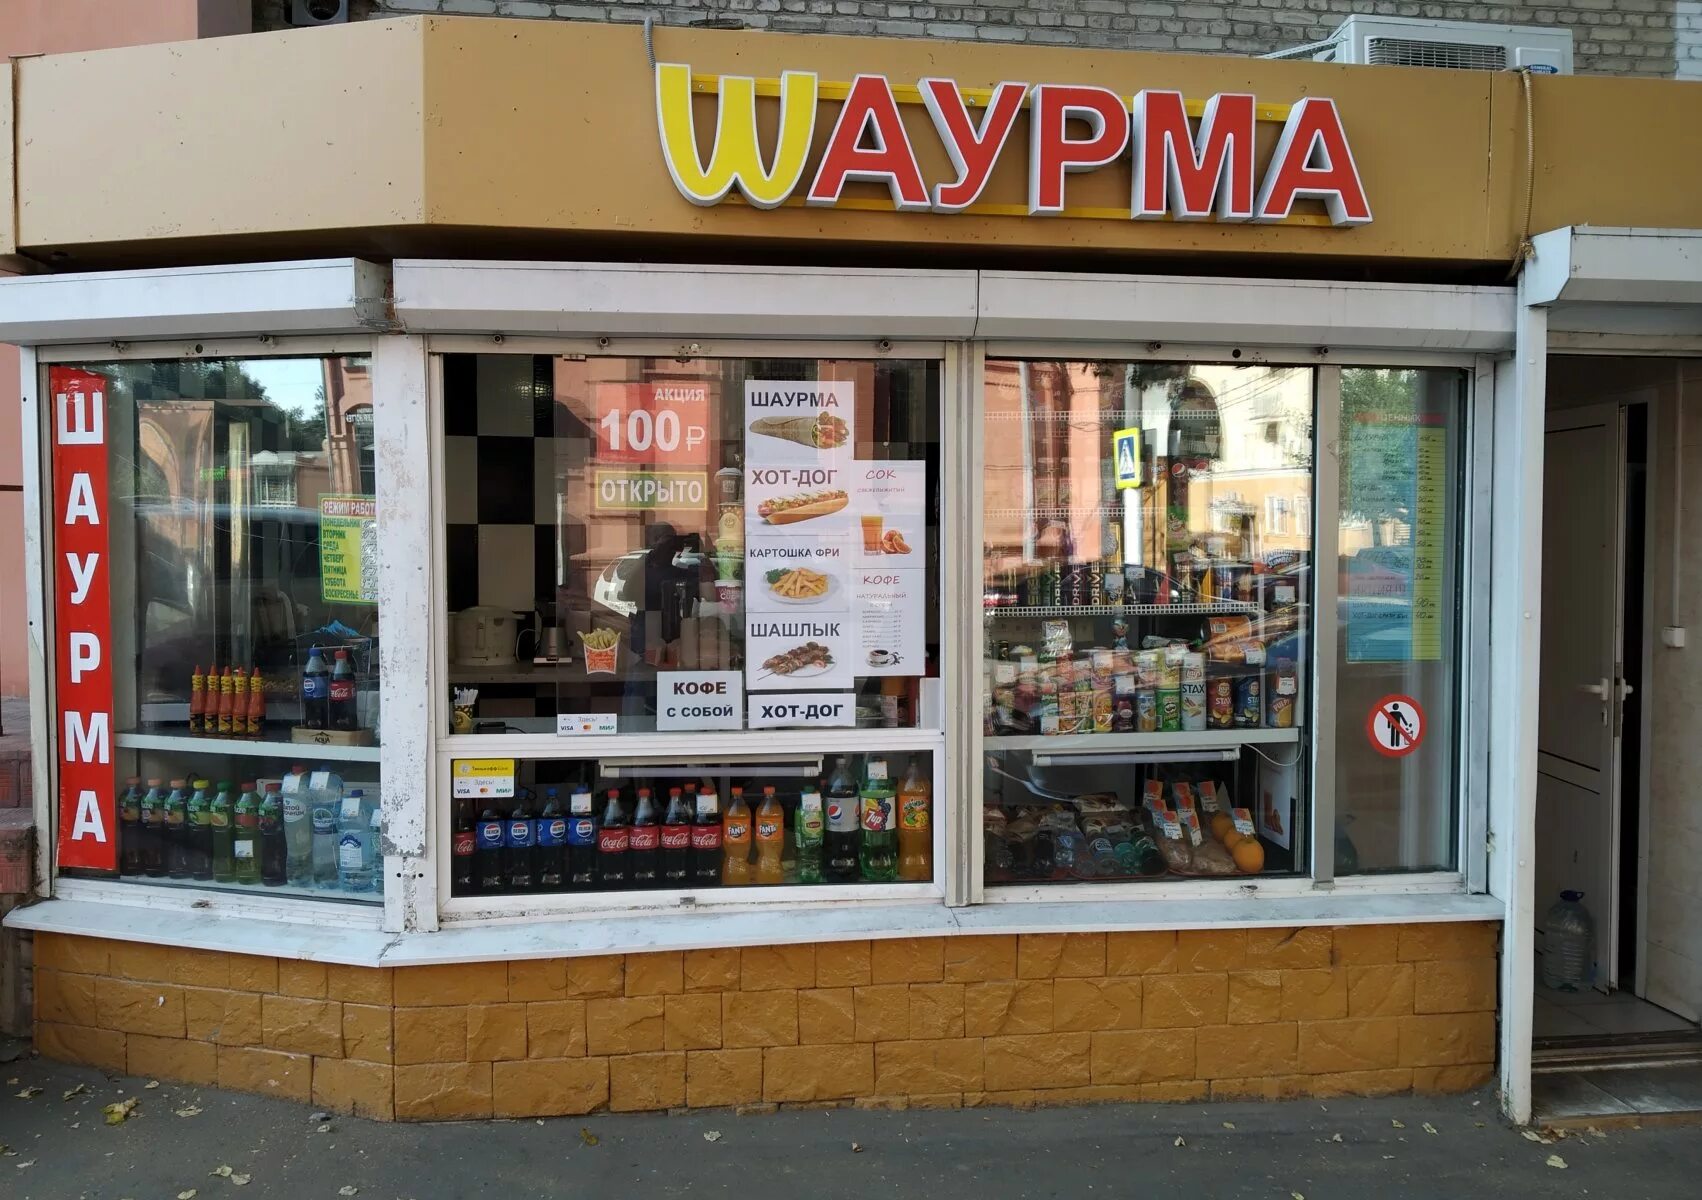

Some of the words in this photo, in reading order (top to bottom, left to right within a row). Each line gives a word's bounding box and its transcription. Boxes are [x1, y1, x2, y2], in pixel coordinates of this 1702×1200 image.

[654, 388, 705, 403] АКЦИЯ
[750, 391, 839, 407] ШАУРМА
[751, 469, 838, 488] ХОТ-ДОГ
[865, 469, 897, 480] СОК
[601, 479, 703, 503] ОТКРЫТО
[323, 502, 350, 514] РЕЖИМ
[350, 503, 376, 516] РАБОТ
[323, 530, 346, 539] ВТОРНИК
[750, 548, 812, 559] КАРТОШКА
[815, 548, 840, 558] ФРИ
[323, 566, 347, 575] ПЯТНИЦА
[863, 575, 900, 585] КОФЕ
[57, 392, 110, 843] ШАУРМА
[750, 623, 841, 637] ШАШЛЫК
[673, 682, 727, 695] КОФЕ
[1181, 683, 1205, 694] STAX
[1215, 697, 1232, 705] STAX
[1247, 696, 1260, 704] STA
[666, 706, 676, 718] С
[681, 704, 733, 717] СОБОЙ
[761, 704, 844, 719] ХОТ-ДОГ
